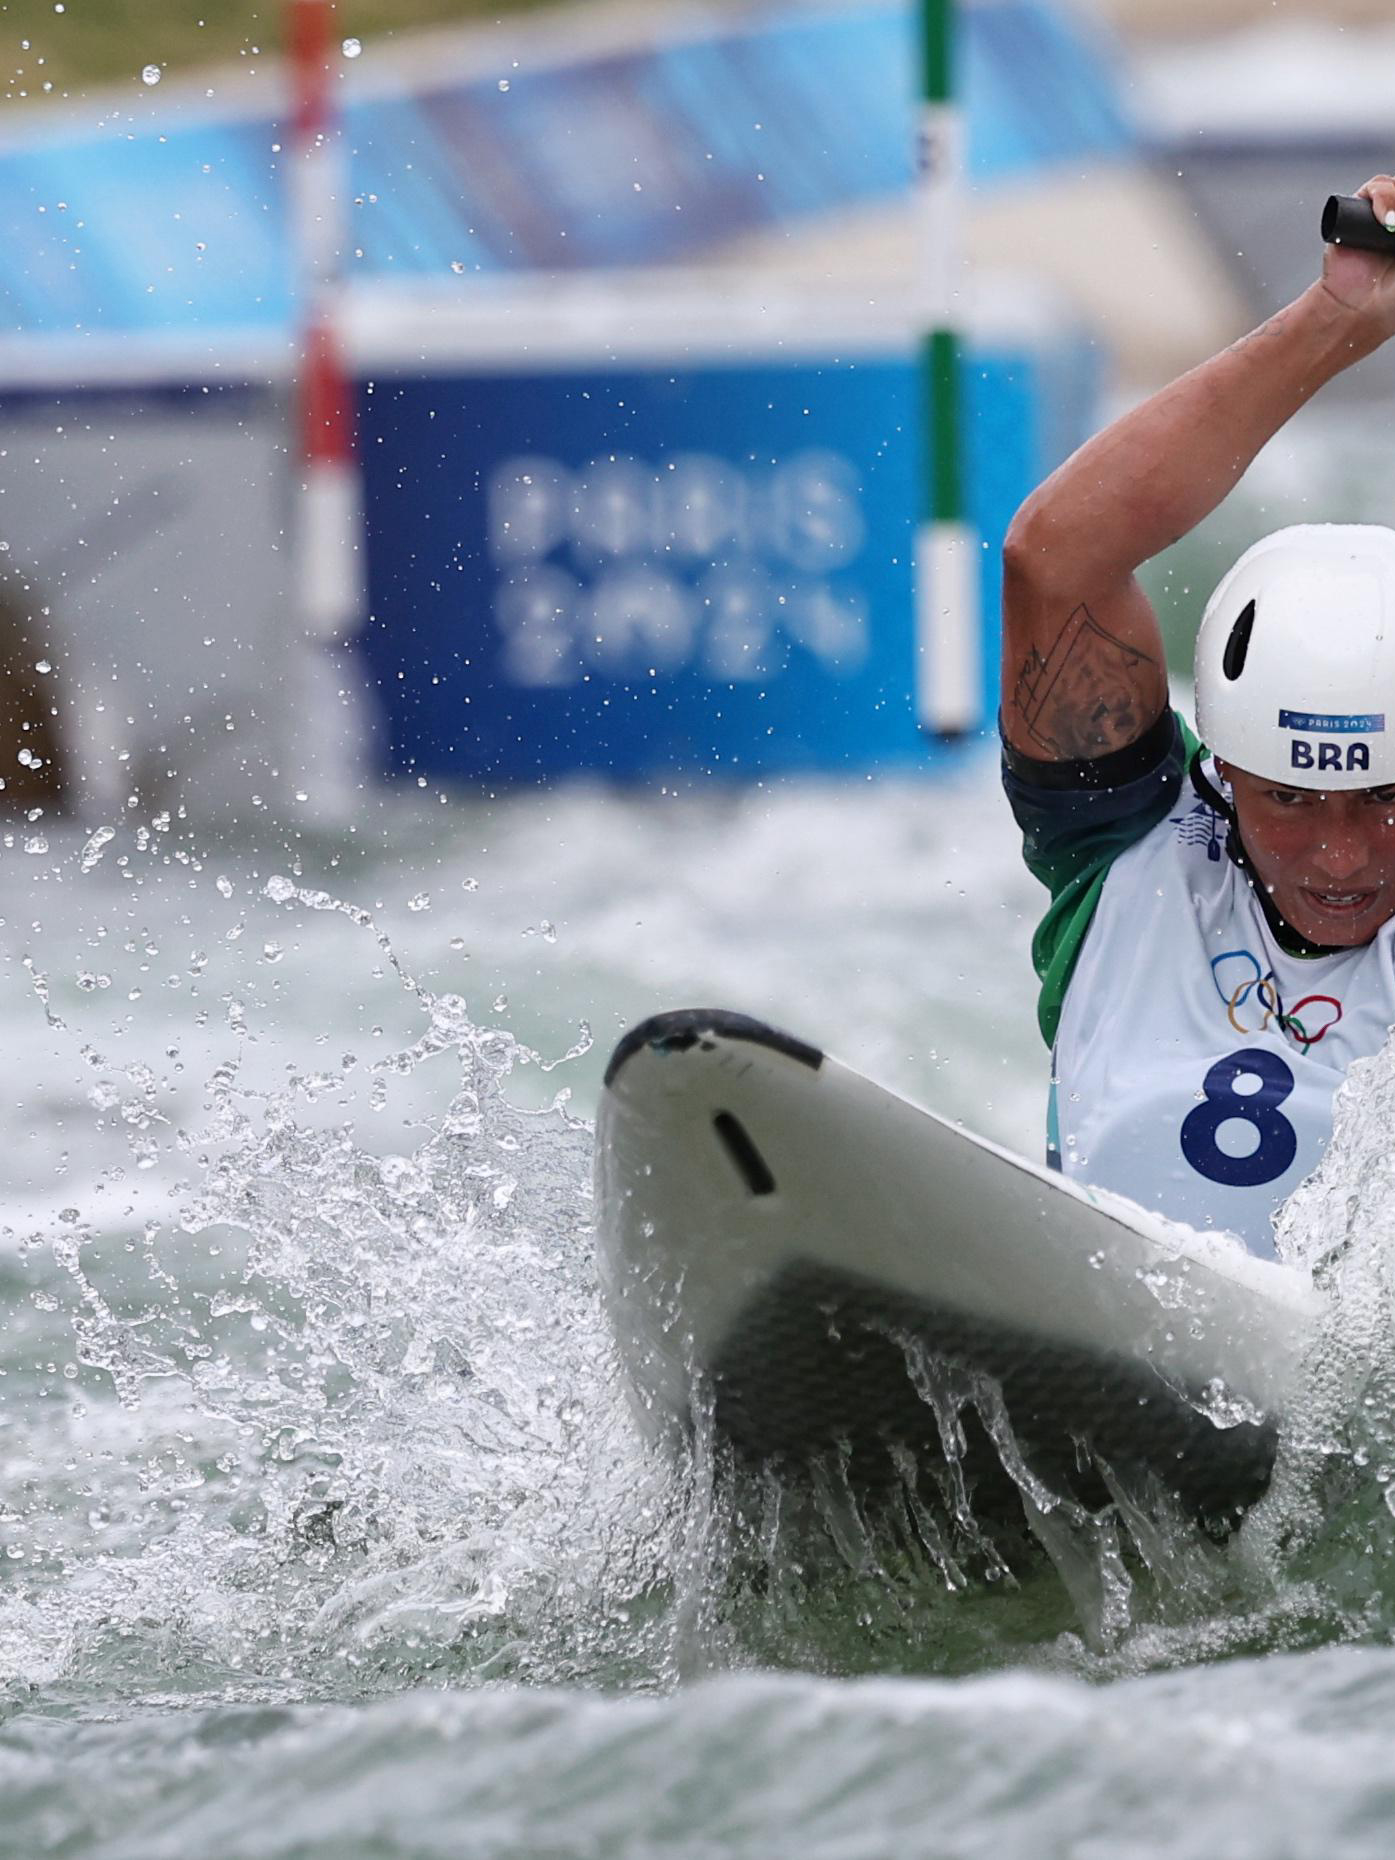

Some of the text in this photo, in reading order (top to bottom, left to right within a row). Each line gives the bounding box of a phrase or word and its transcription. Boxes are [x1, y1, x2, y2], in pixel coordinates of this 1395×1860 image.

[486, 452, 866, 570] PARIS
[496, 568, 870, 686] 2024
[1291, 739, 1370, 771] BRA
[1308, 718, 1372, 729] PARIS 2024
[1180, 1048, 1297, 1187] 8
